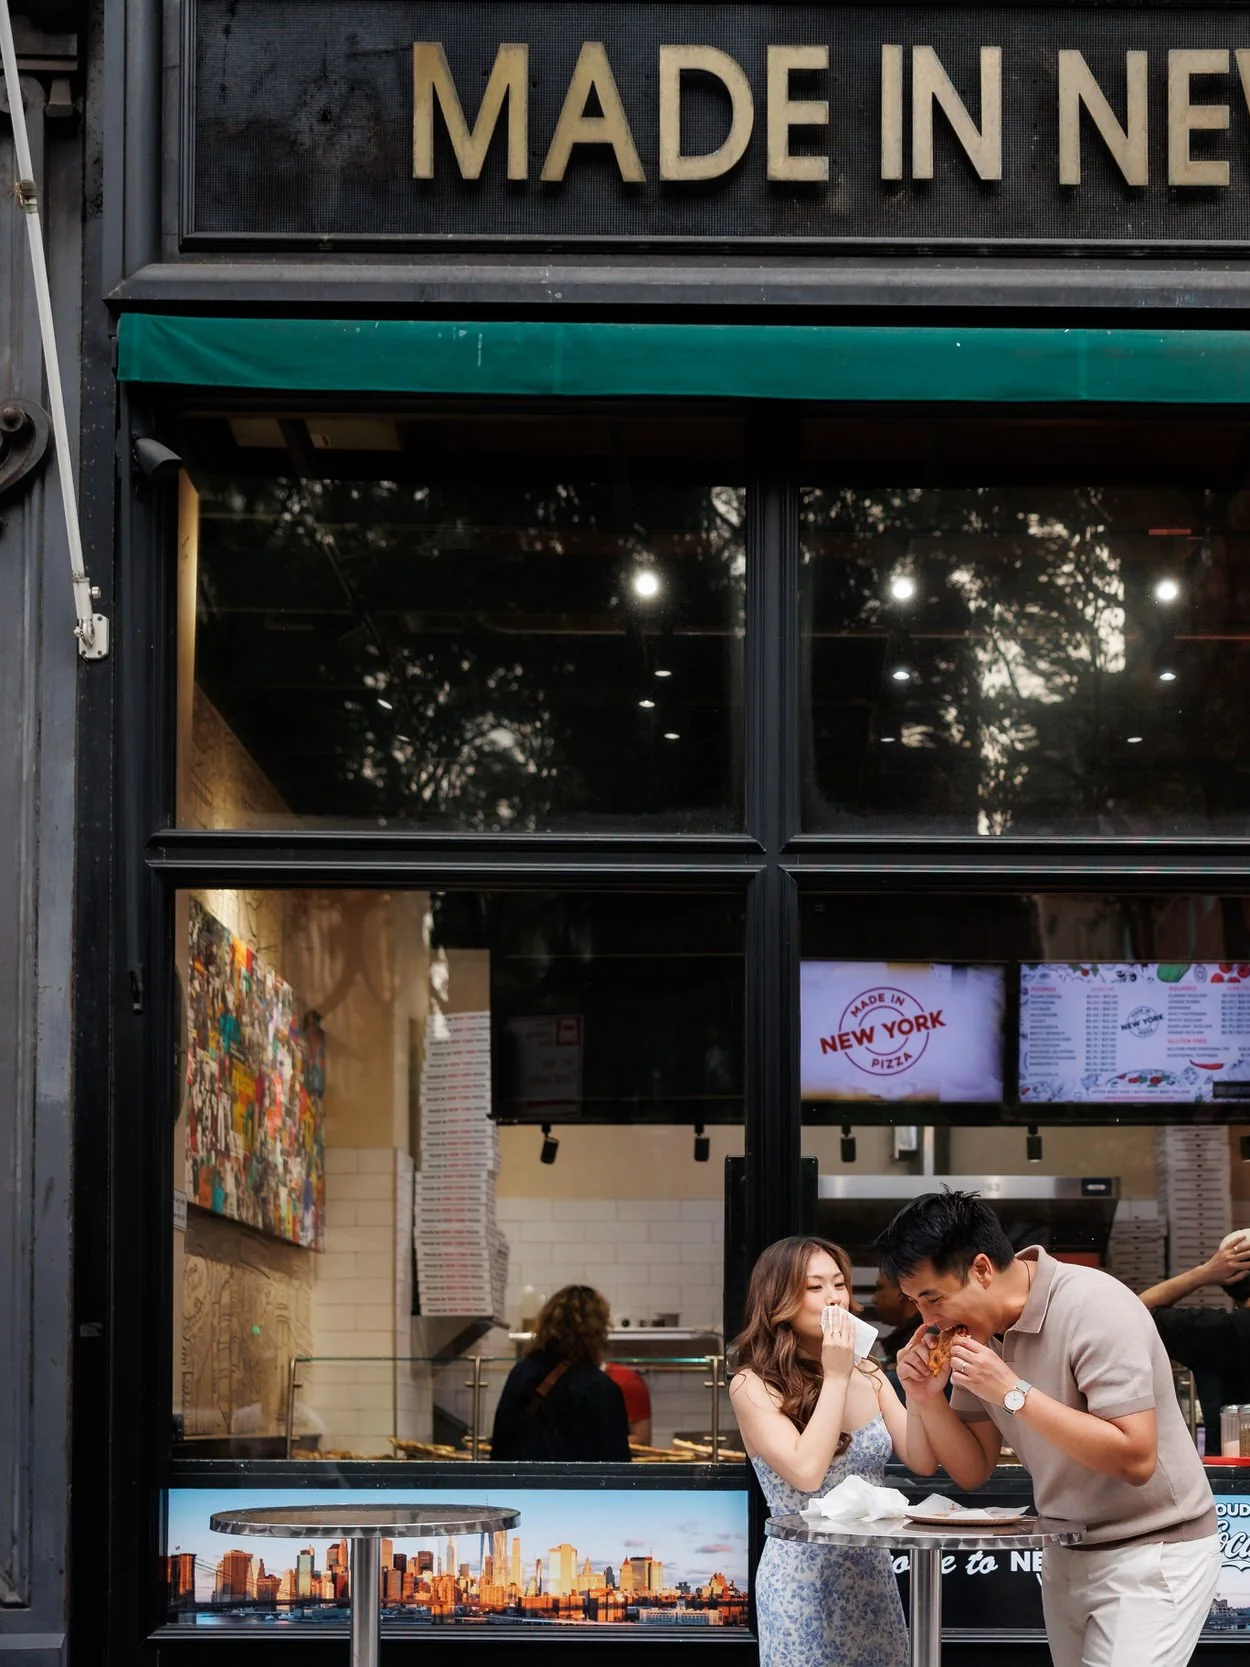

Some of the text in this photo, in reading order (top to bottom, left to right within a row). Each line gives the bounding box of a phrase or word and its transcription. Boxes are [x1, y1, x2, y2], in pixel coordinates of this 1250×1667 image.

[412, 41, 830, 183] MADE
[881, 44, 1001, 182] IN
[850, 993, 905, 1018] MADE IN
[819, 1009, 947, 1055] NEW YORK
[871, 1051, 913, 1069] PIZZA
[965, 1550, 999, 1575] to
[1010, 1550, 1043, 1572] NE
